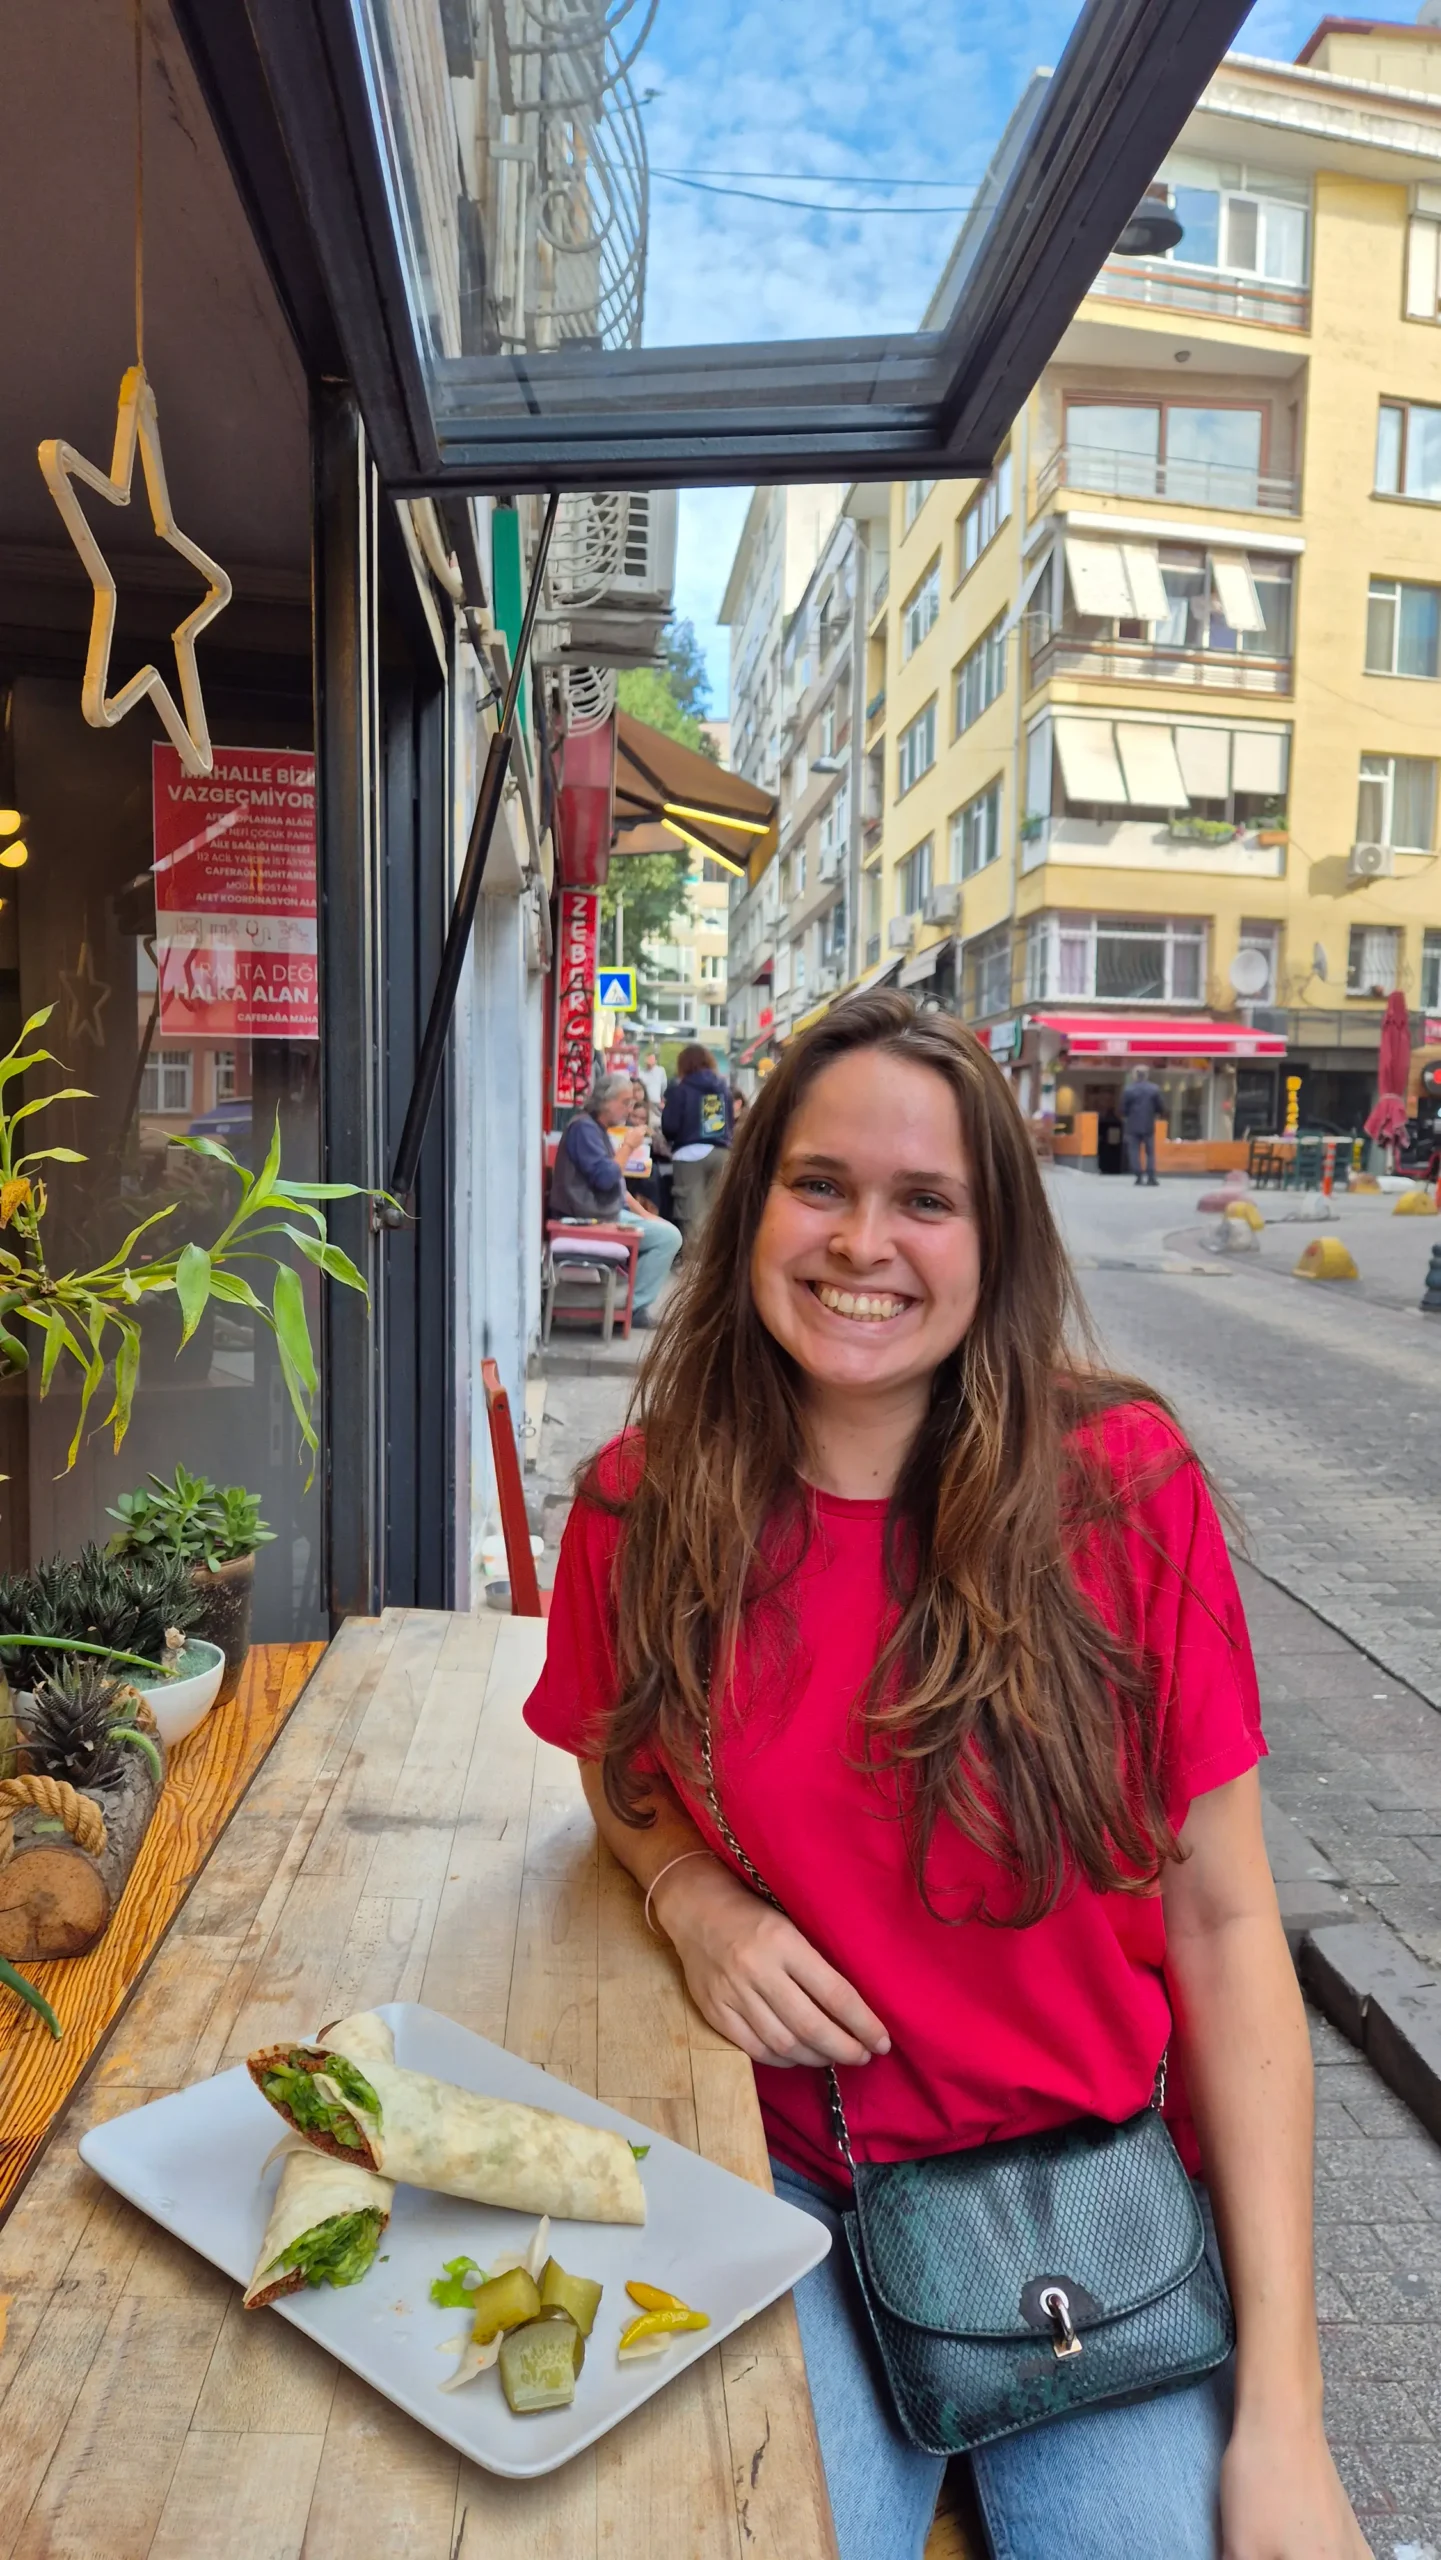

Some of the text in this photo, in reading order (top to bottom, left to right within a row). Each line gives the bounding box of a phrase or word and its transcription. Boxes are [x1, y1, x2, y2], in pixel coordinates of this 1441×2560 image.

[285, 816, 313, 827] ALANI
[250, 829, 285, 839] ÇOCUK
[210, 840, 230, 850] AİLE
[196, 852, 209, 861] 112
[211, 852, 232, 863] ACİL
[205, 866, 257, 877] CAFERAĞA
[226, 881, 255, 891] MODA
[195, 892, 219, 902] AFET
[200, 962, 266, 981] RANTA
[174, 984, 248, 1003] HALKA
[252, 985, 308, 1004] ALAN
[237, 1012, 289, 1023] CAFERAĞA
